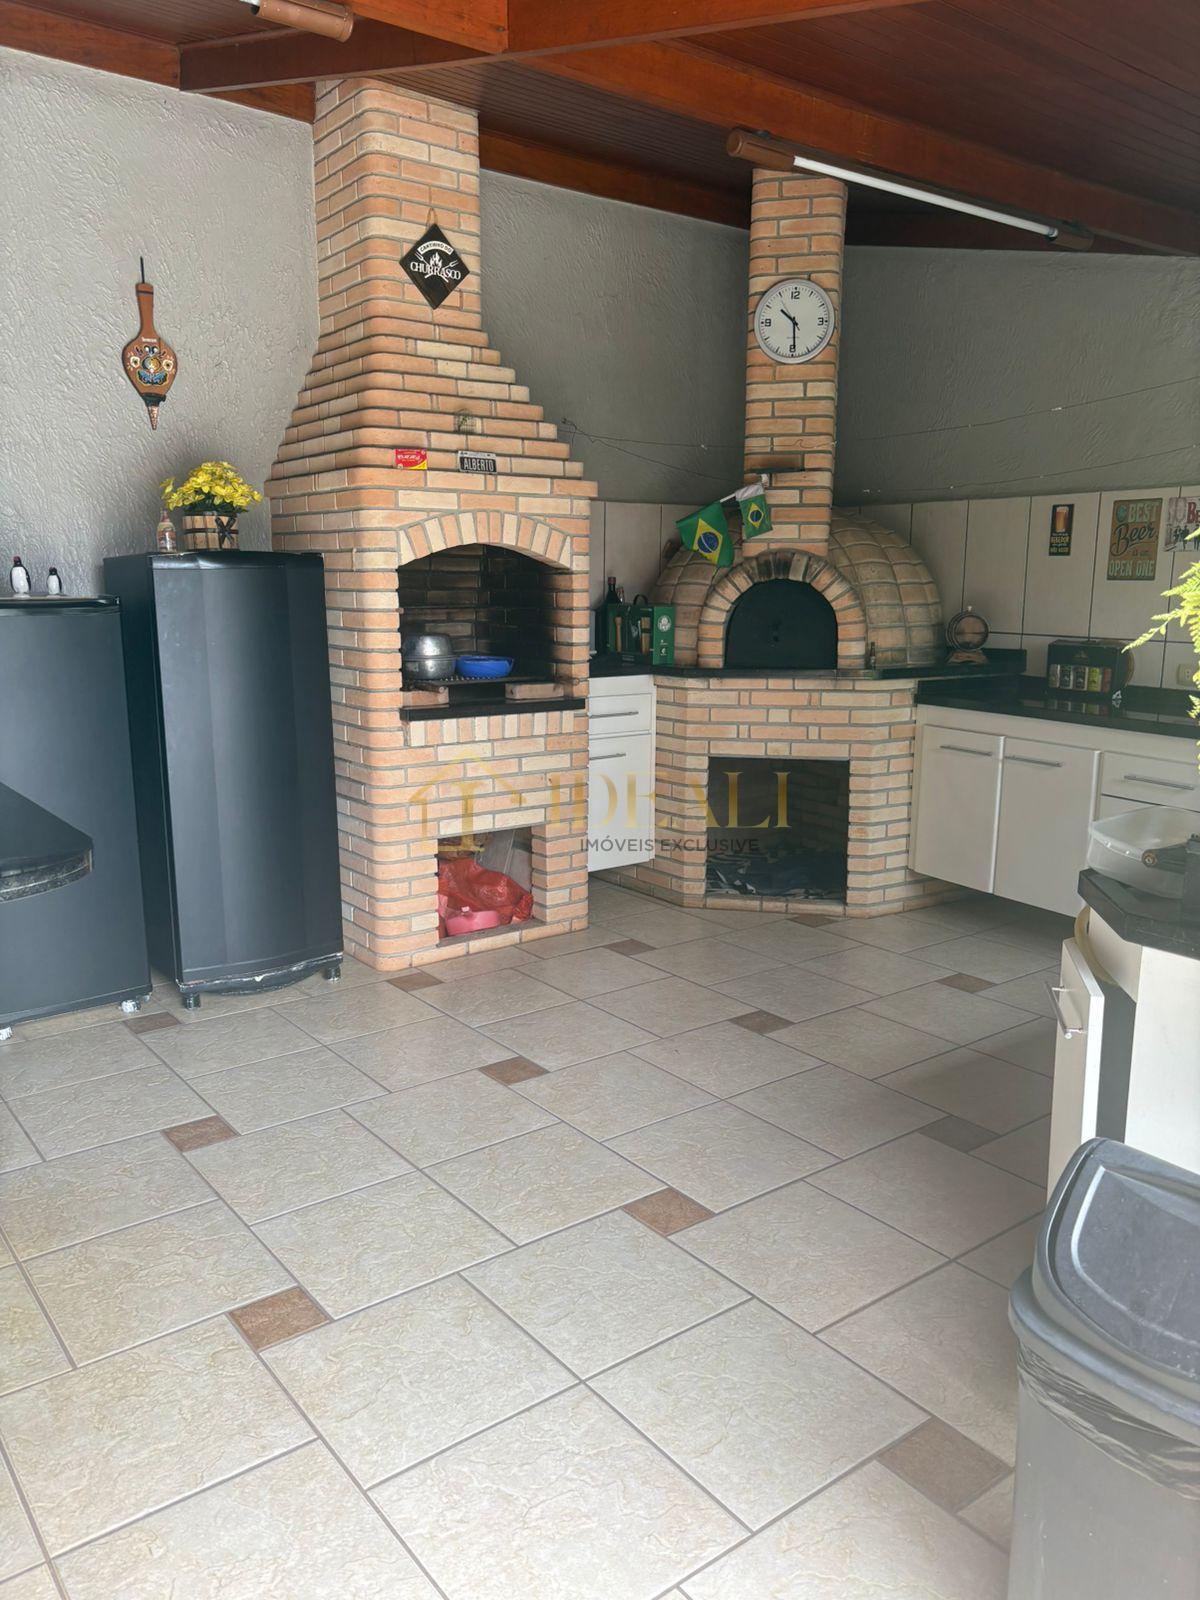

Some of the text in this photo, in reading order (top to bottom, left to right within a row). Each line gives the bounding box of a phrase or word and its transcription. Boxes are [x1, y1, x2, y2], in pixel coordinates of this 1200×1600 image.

[410, 261, 461, 280] CHURRASCO
[790, 291, 800, 300] 12
[764, 318, 771, 327] 9
[817, 317, 824, 326] 3
[463, 457, 494, 472] ALBERTO
[1128, 502, 1160, 523] BEST
[1110, 523, 1156, 556] Beer
[1108, 560, 1155, 577] OPEN ONE
